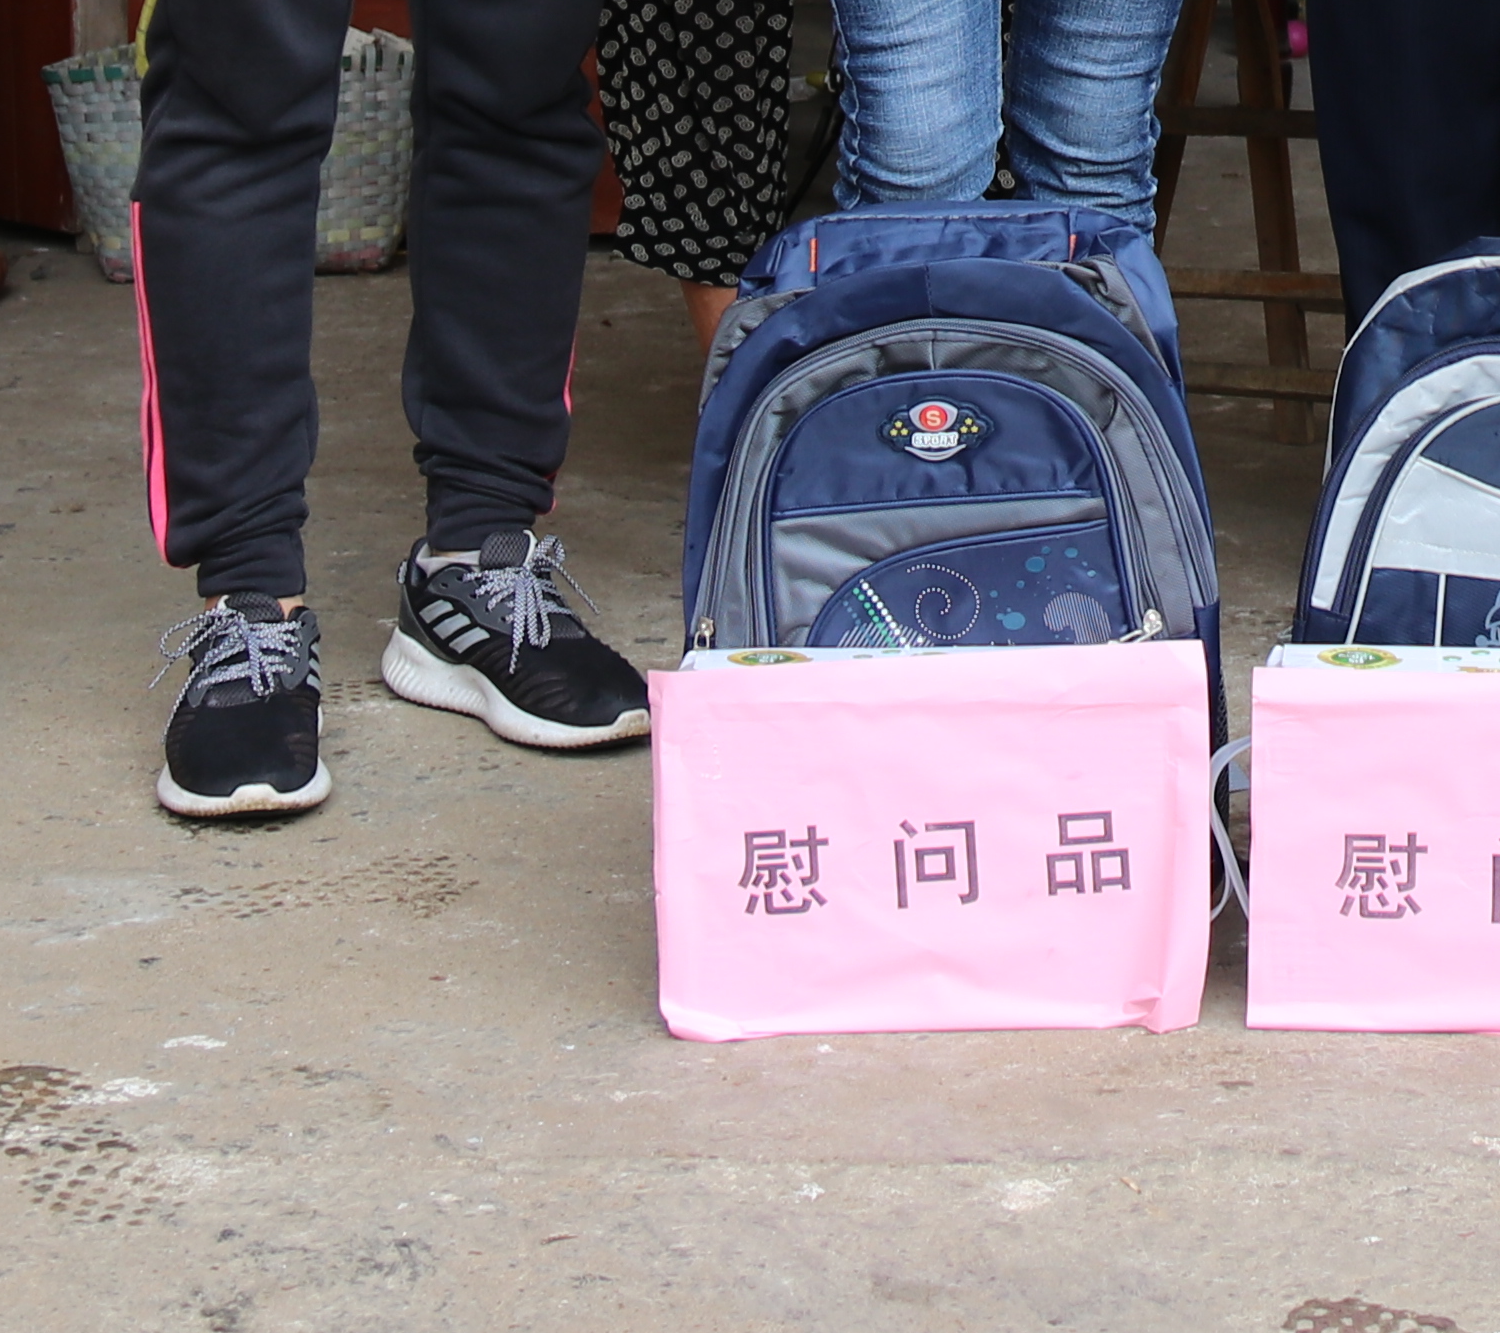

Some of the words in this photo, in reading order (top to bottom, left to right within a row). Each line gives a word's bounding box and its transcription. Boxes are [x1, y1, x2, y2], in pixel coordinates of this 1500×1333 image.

[925, 410, 942, 427] S
[913, 433, 957, 446] SPORT
[737, 809, 1132, 917] 慰问品
